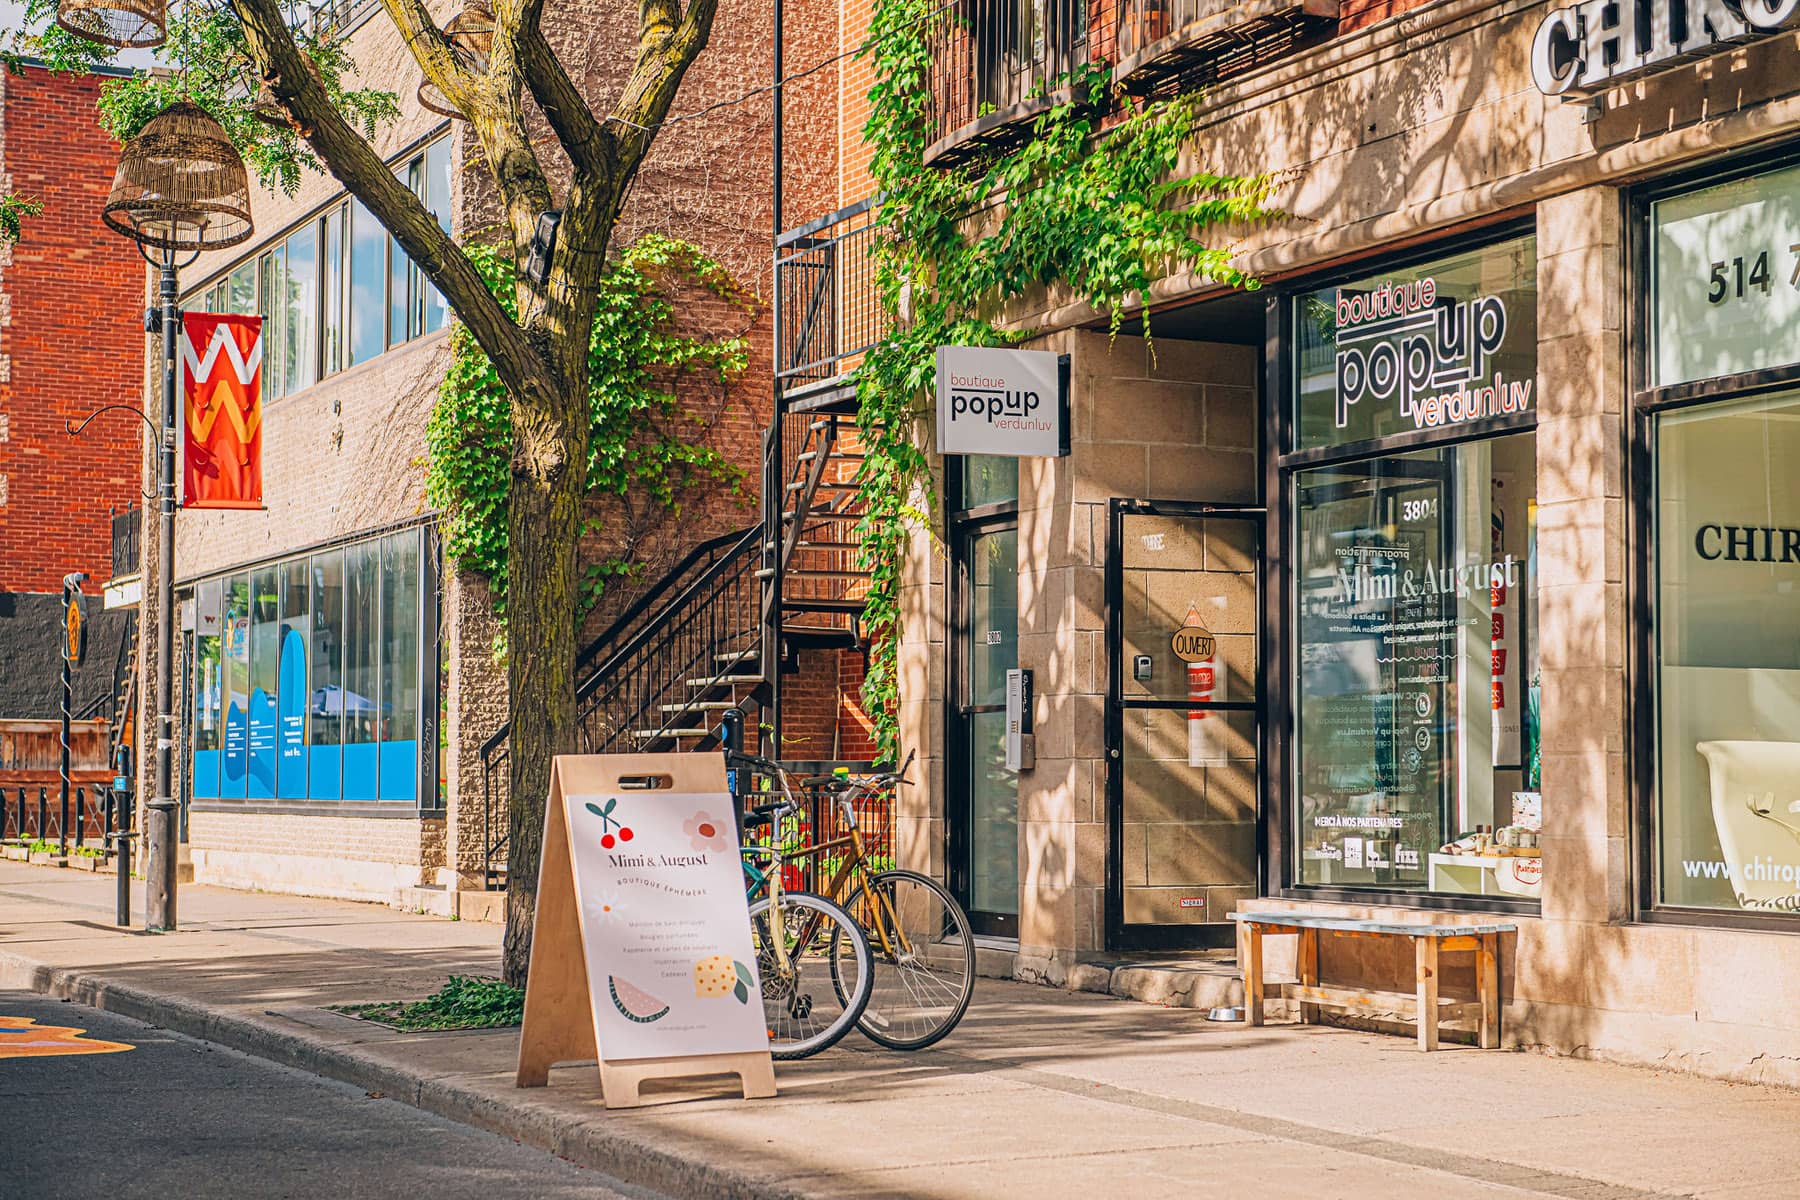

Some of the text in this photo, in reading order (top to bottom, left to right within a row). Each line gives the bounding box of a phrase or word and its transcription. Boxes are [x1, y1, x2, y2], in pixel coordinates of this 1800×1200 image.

[1708, 250, 1771, 304] 514
[1335, 277, 1436, 327] boutique
[1335, 295, 1507, 428] popup
[950, 372, 1005, 388] boutique
[951, 390, 1040, 423] popup
[1411, 371, 1532, 428] verdunluv
[993, 418, 1052, 431] verdunluv
[1403, 498, 1438, 521] 3804
[1336, 554, 1516, 603] Mimi & August
[1176, 634, 1213, 656] OUVERT
[1314, 815, 1336, 827] MERCI
[1342, 816, 1357, 828] NOS
[1356, 816, 1403, 829] PARTENAIRES
[609, 853, 709, 869] Mimi & August
[617, 877, 661, 890] BOUTIQUE
